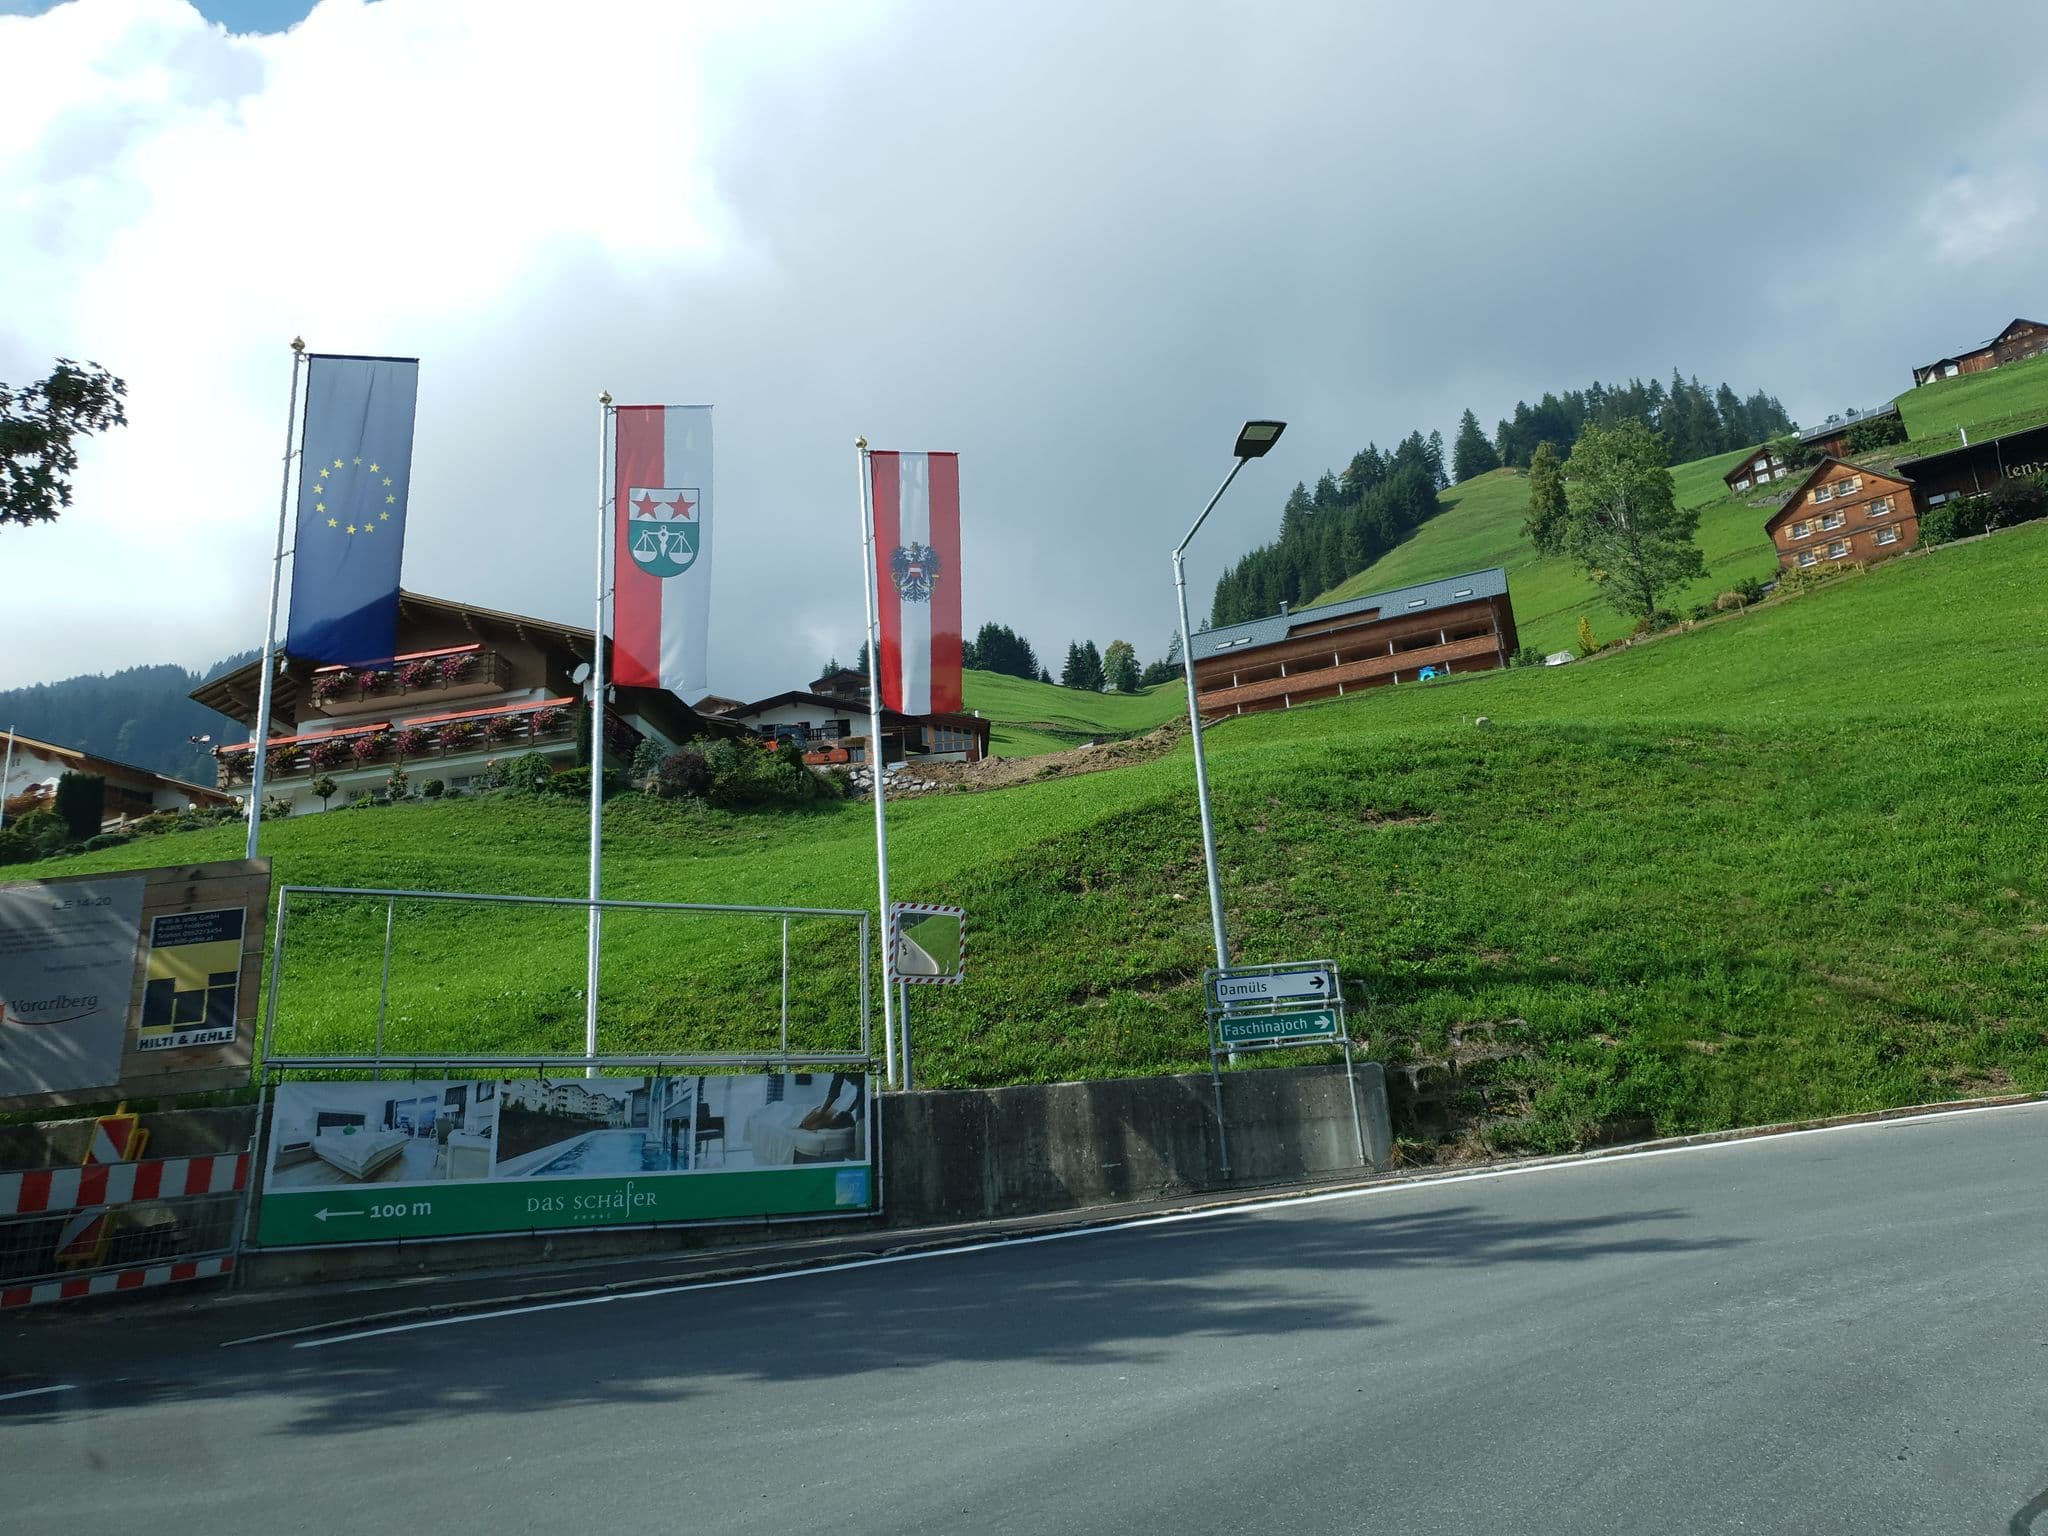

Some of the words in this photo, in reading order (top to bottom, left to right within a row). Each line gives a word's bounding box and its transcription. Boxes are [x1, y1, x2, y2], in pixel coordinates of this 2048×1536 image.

[1220, 981, 1267, 996] Damüls
[11, 994, 98, 1014] Vorarlberg
[1224, 1018, 1308, 1037] Faschinajoch
[139, 1036, 173, 1049] HILTI
[179, 1034, 188, 1045] &
[192, 1030, 233, 1043] JEHLE
[369, 1203, 407, 1218] 100
[412, 1202, 432, 1216] m
